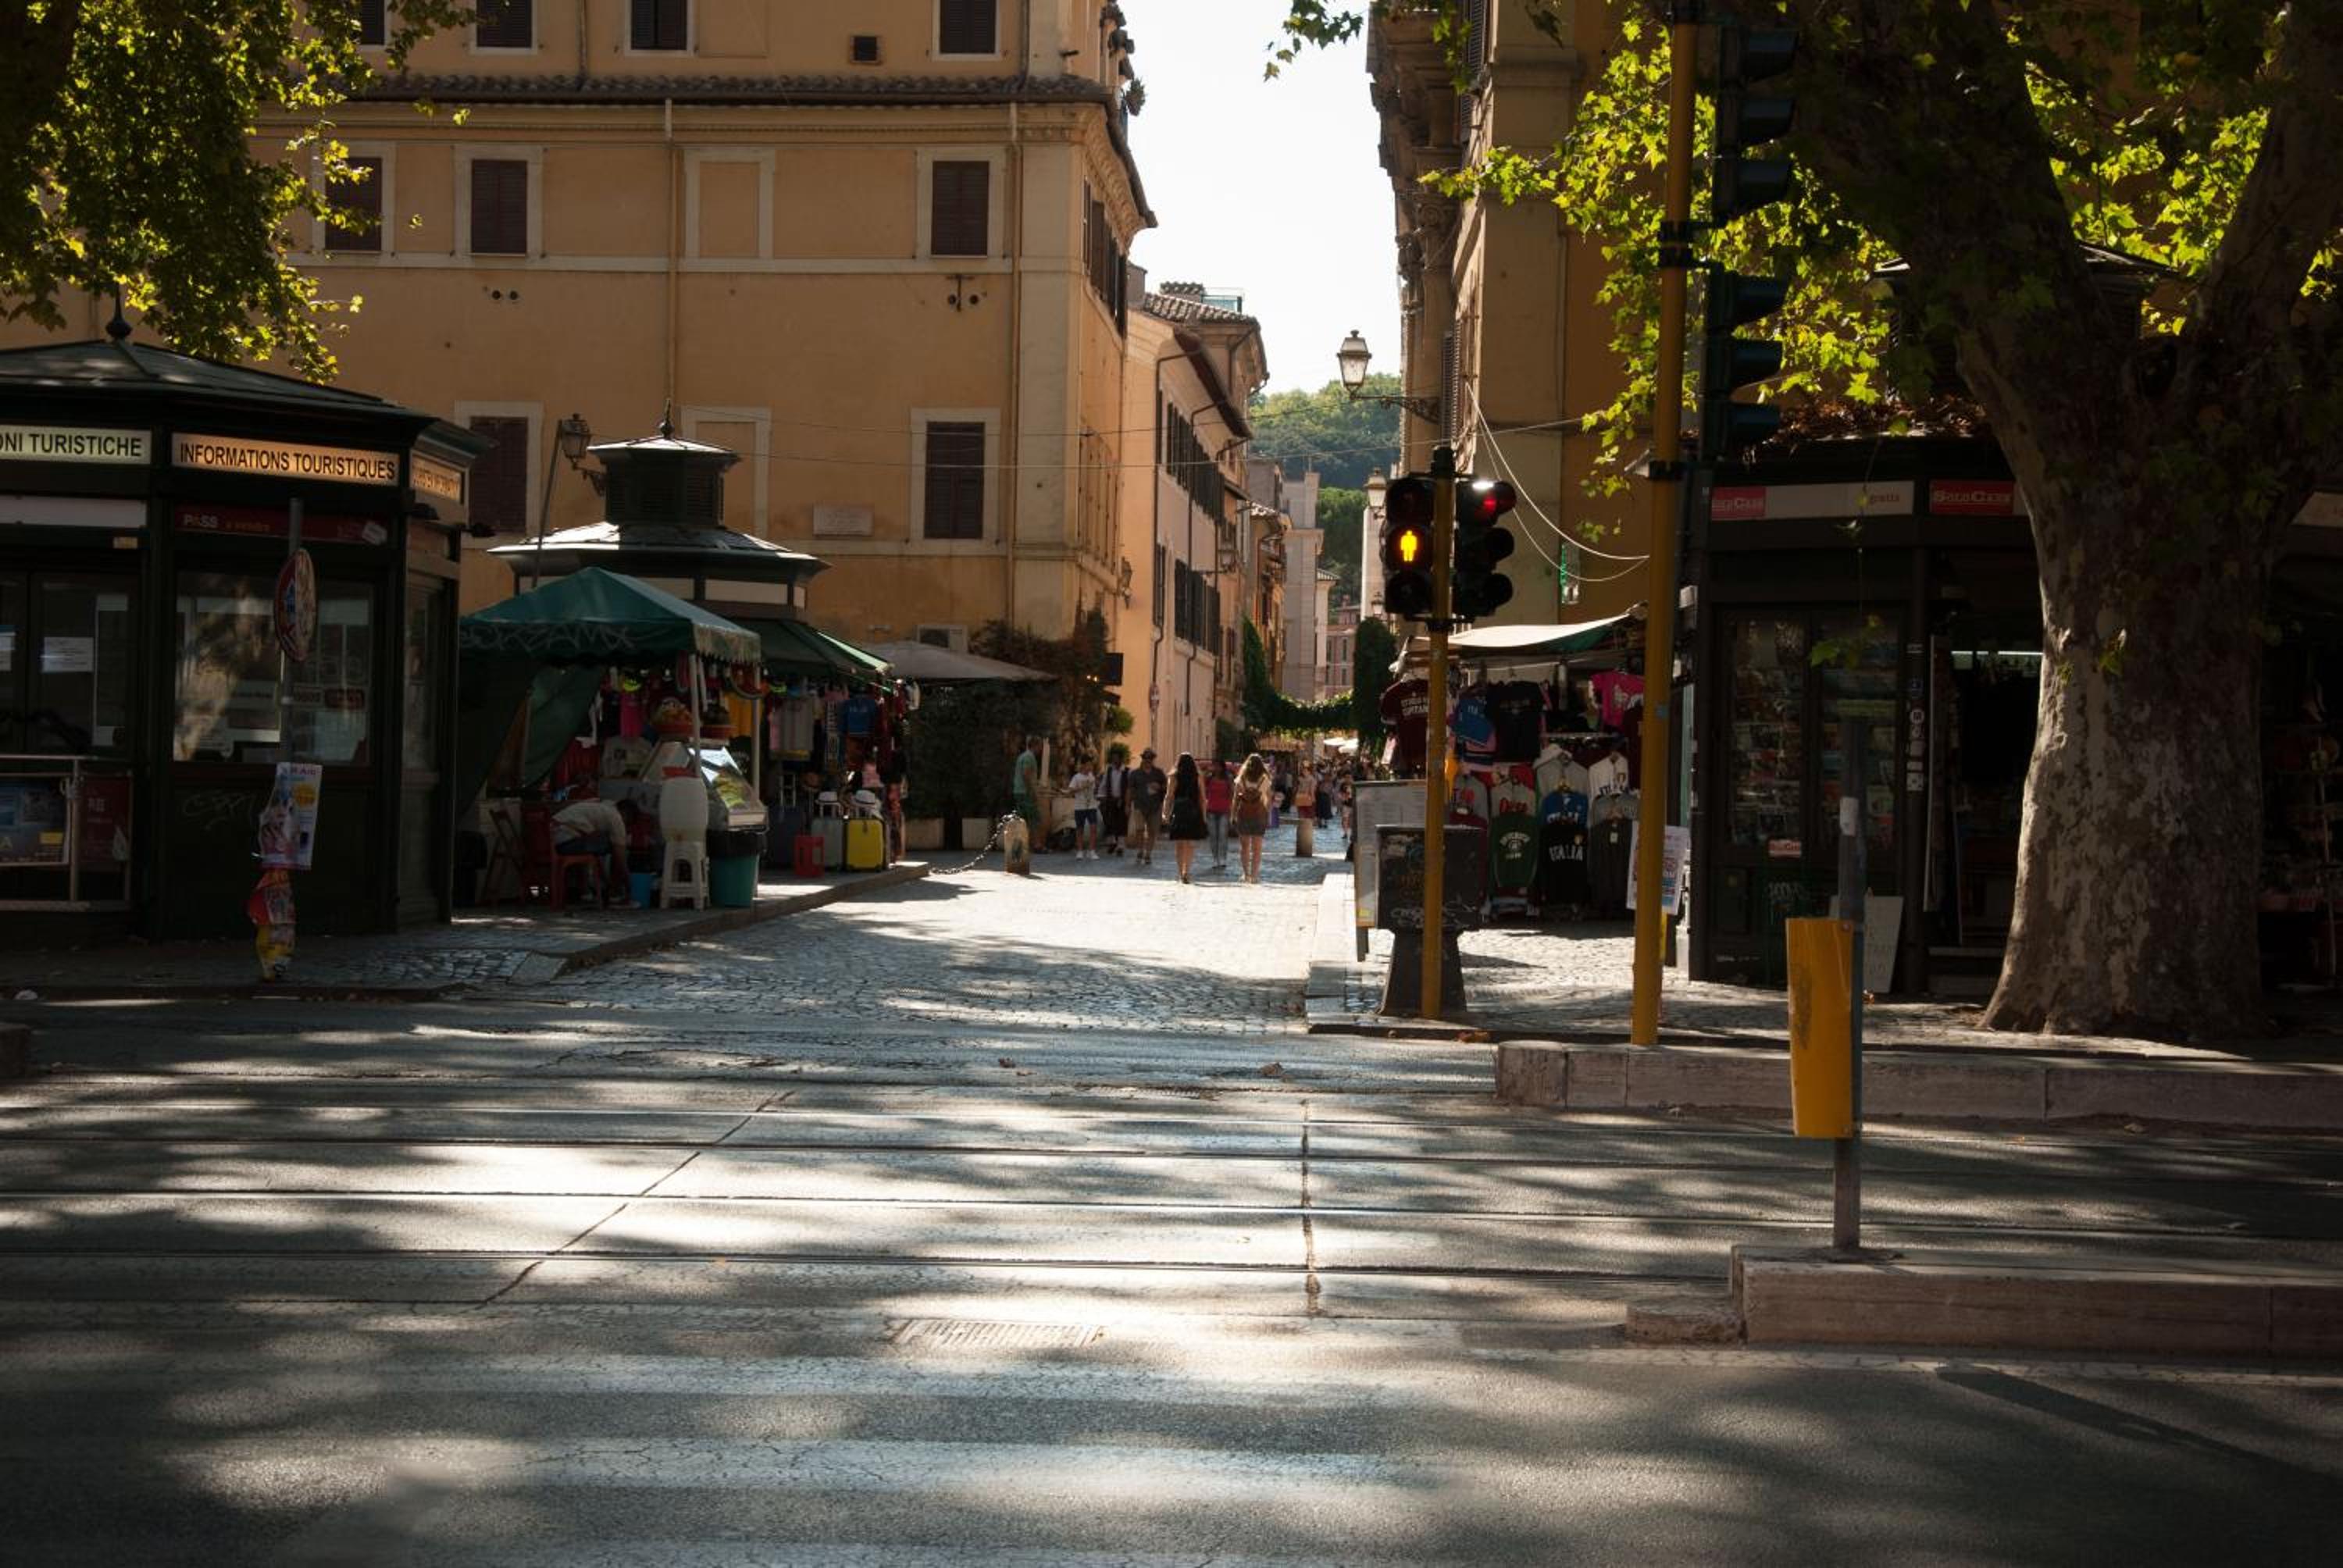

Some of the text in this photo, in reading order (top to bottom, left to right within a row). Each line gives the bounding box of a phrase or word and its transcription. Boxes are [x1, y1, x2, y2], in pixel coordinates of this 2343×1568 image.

[29, 433, 142, 457] TURISTICHE
[180, 442, 395, 480] INFORMATIONS TOURISTIQUES
